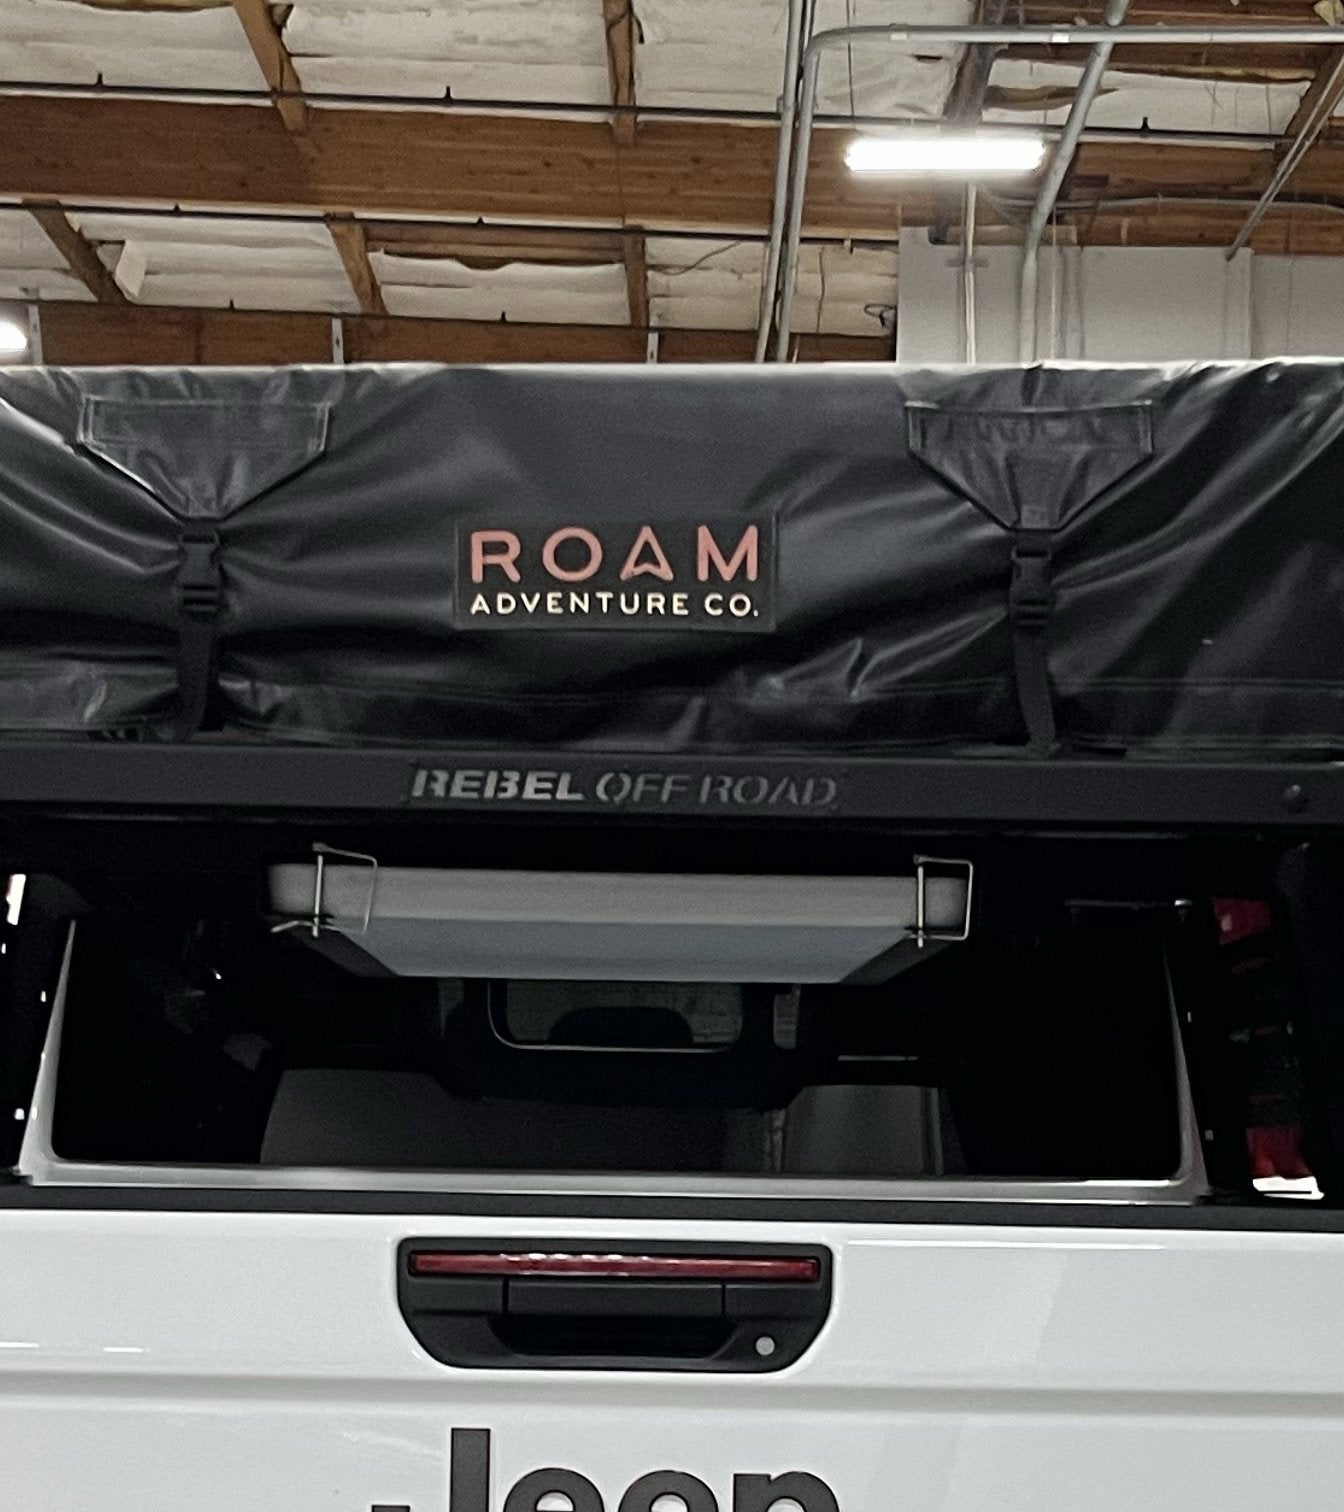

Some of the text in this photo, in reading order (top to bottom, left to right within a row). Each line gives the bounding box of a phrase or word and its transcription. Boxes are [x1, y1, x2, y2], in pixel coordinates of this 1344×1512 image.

[470, 525, 758, 583] ROAM
[470, 592, 759, 618] ADVENTURE CO.
[411, 769, 837, 805] REBEL OFF ROAD
